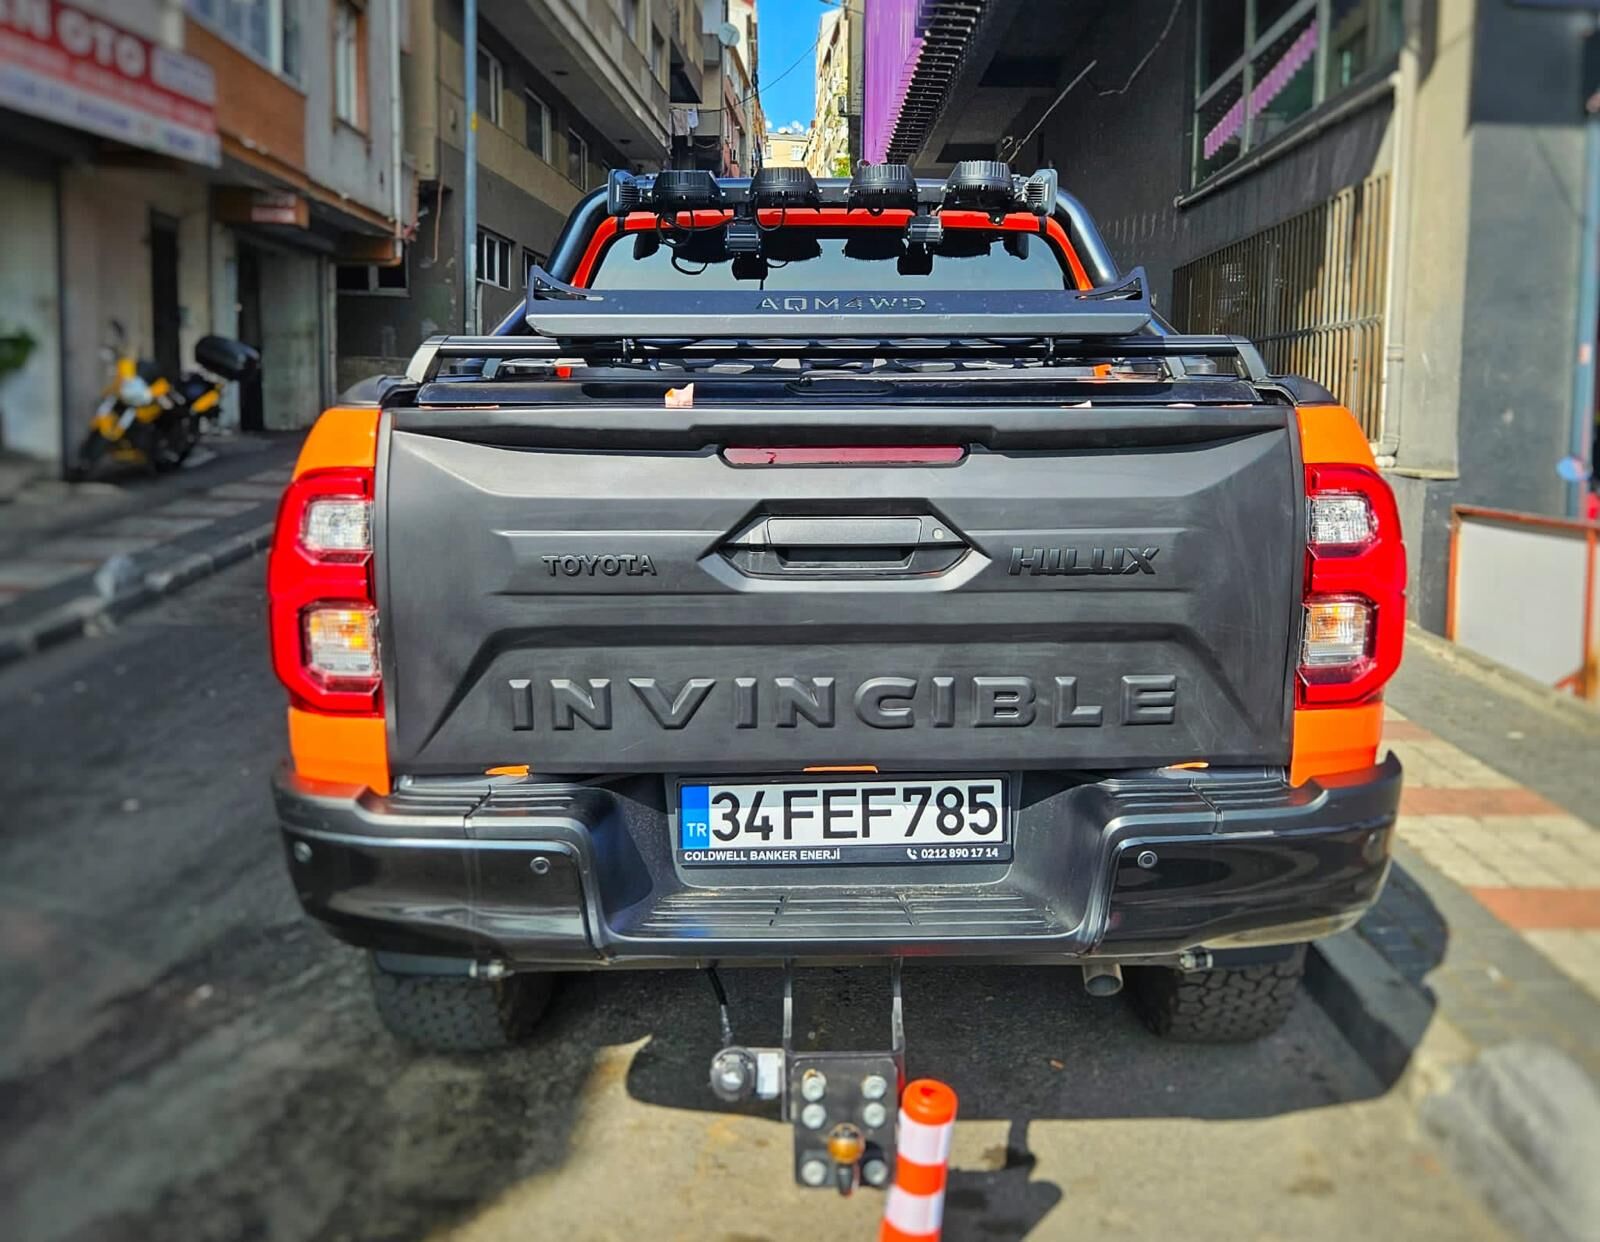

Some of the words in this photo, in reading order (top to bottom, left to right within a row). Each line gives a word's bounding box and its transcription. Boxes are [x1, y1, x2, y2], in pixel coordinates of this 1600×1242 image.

[56, 7, 146, 78] OTO
[755, 296, 927, 311] AQM4WD
[541, 554, 657, 576] TOYOTA
[1007, 547, 1160, 576] HILUX
[508, 675, 1178, 731] INVINCIBLE
[711, 791, 774, 841] 34
[783, 787, 896, 840] FEF
[902, 785, 998, 836] 785
[687, 823, 707, 837] TR
[684, 850, 747, 861] COLDWELL
[750, 850, 798, 861] BANKER
[801, 848, 841, 860] ENERJİ
[921, 849, 947, 859] 0212
[949, 848, 969, 858] 890
[971, 848, 984, 858] 17
[985, 848, 999, 857] 14
